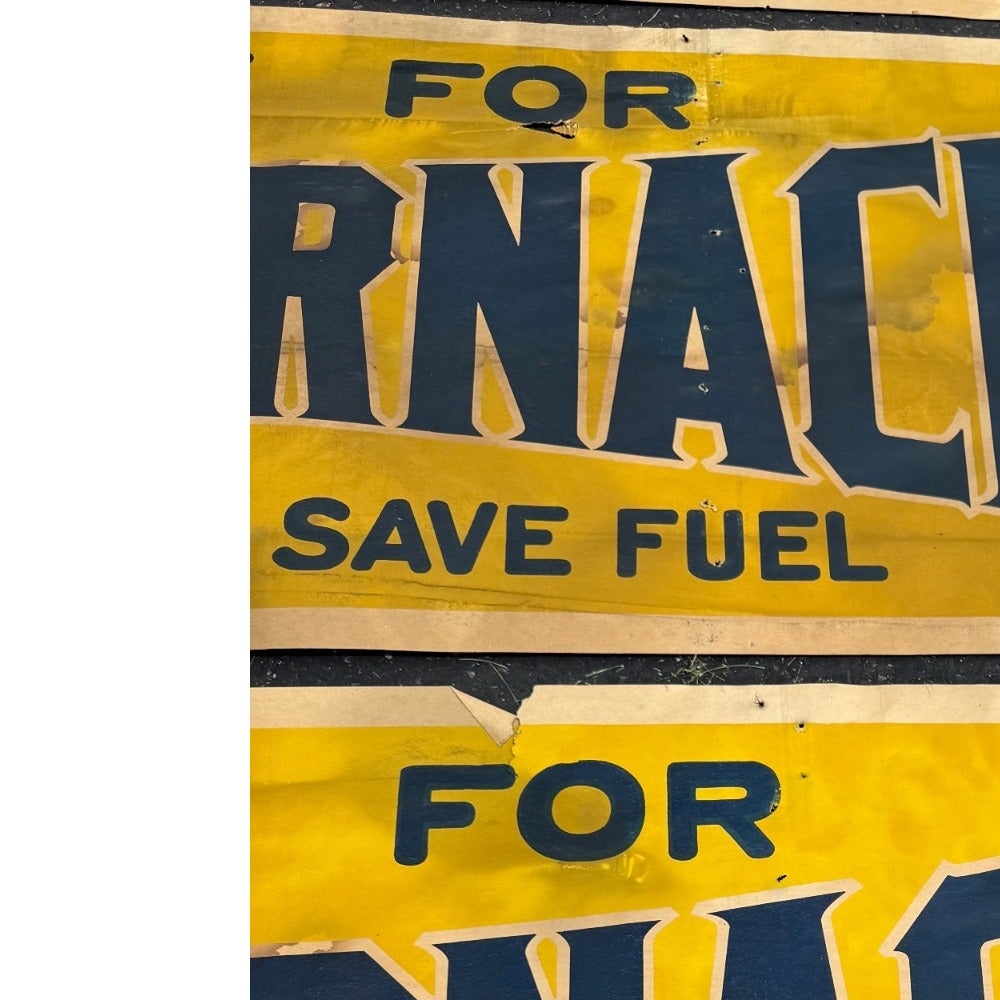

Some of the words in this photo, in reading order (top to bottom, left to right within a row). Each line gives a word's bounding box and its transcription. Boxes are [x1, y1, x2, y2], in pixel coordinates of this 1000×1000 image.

[384, 59, 697, 130] FOR
[271, 497, 572, 577] SAVE
[616, 508, 889, 582] FUEL
[393, 759, 781, 867] FOR
